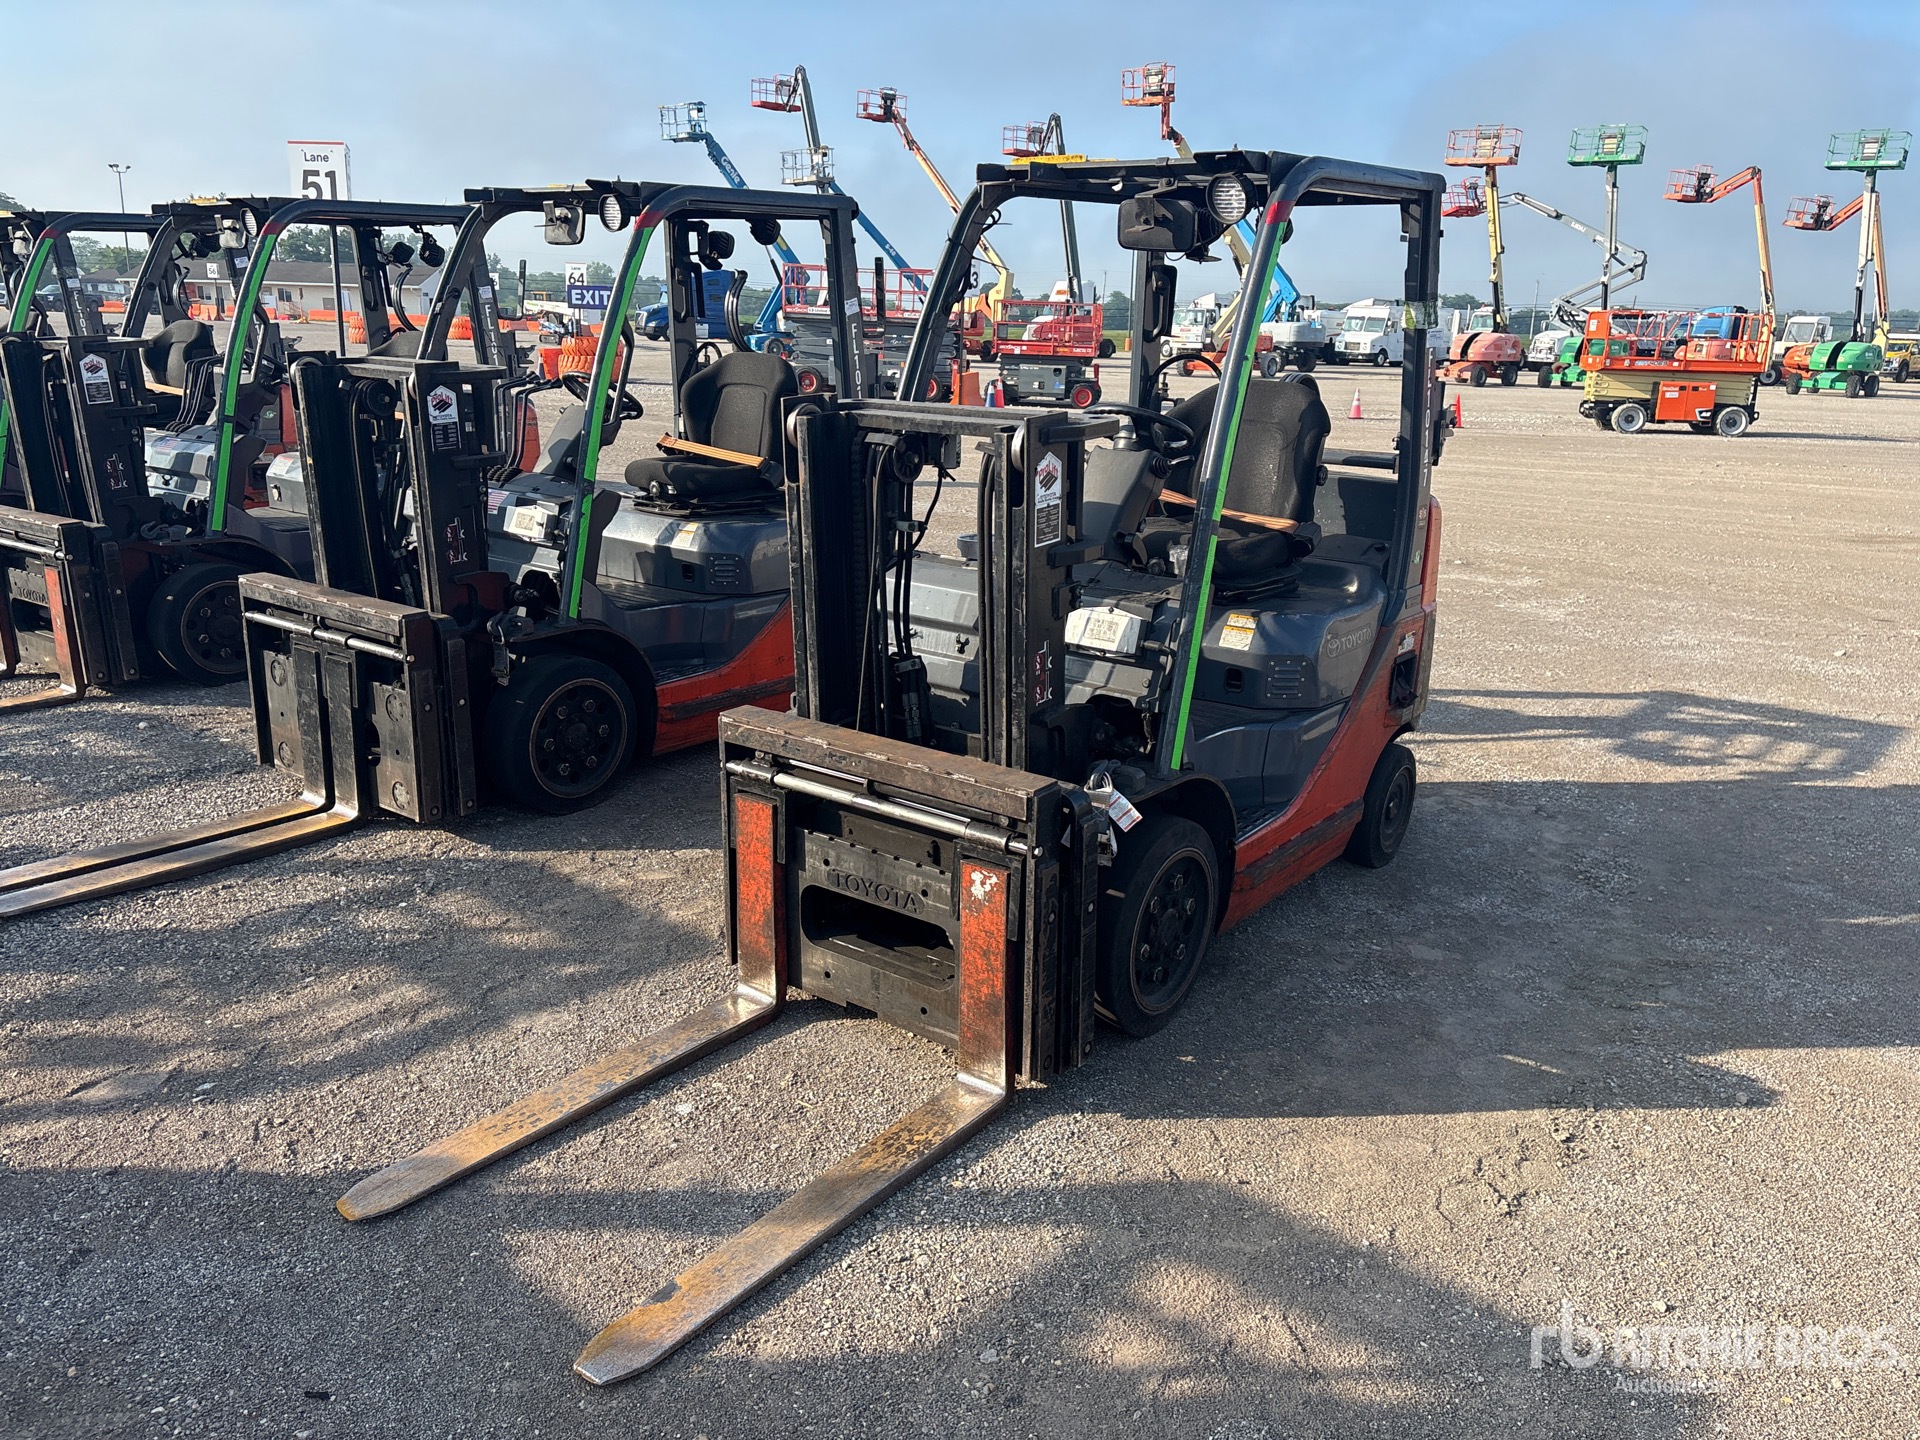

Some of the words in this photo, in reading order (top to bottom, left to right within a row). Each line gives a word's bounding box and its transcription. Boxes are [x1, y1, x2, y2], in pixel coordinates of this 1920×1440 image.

[303, 151, 330, 163] Lane
[720, 155, 741, 185] Genie
[301, 169, 338, 201] 51
[568, 272, 585, 286] 64
[571, 289, 611, 306] EXIT
[1340, 627, 1374, 651] TOYOTA
[832, 869, 918, 913] TOYOTA
